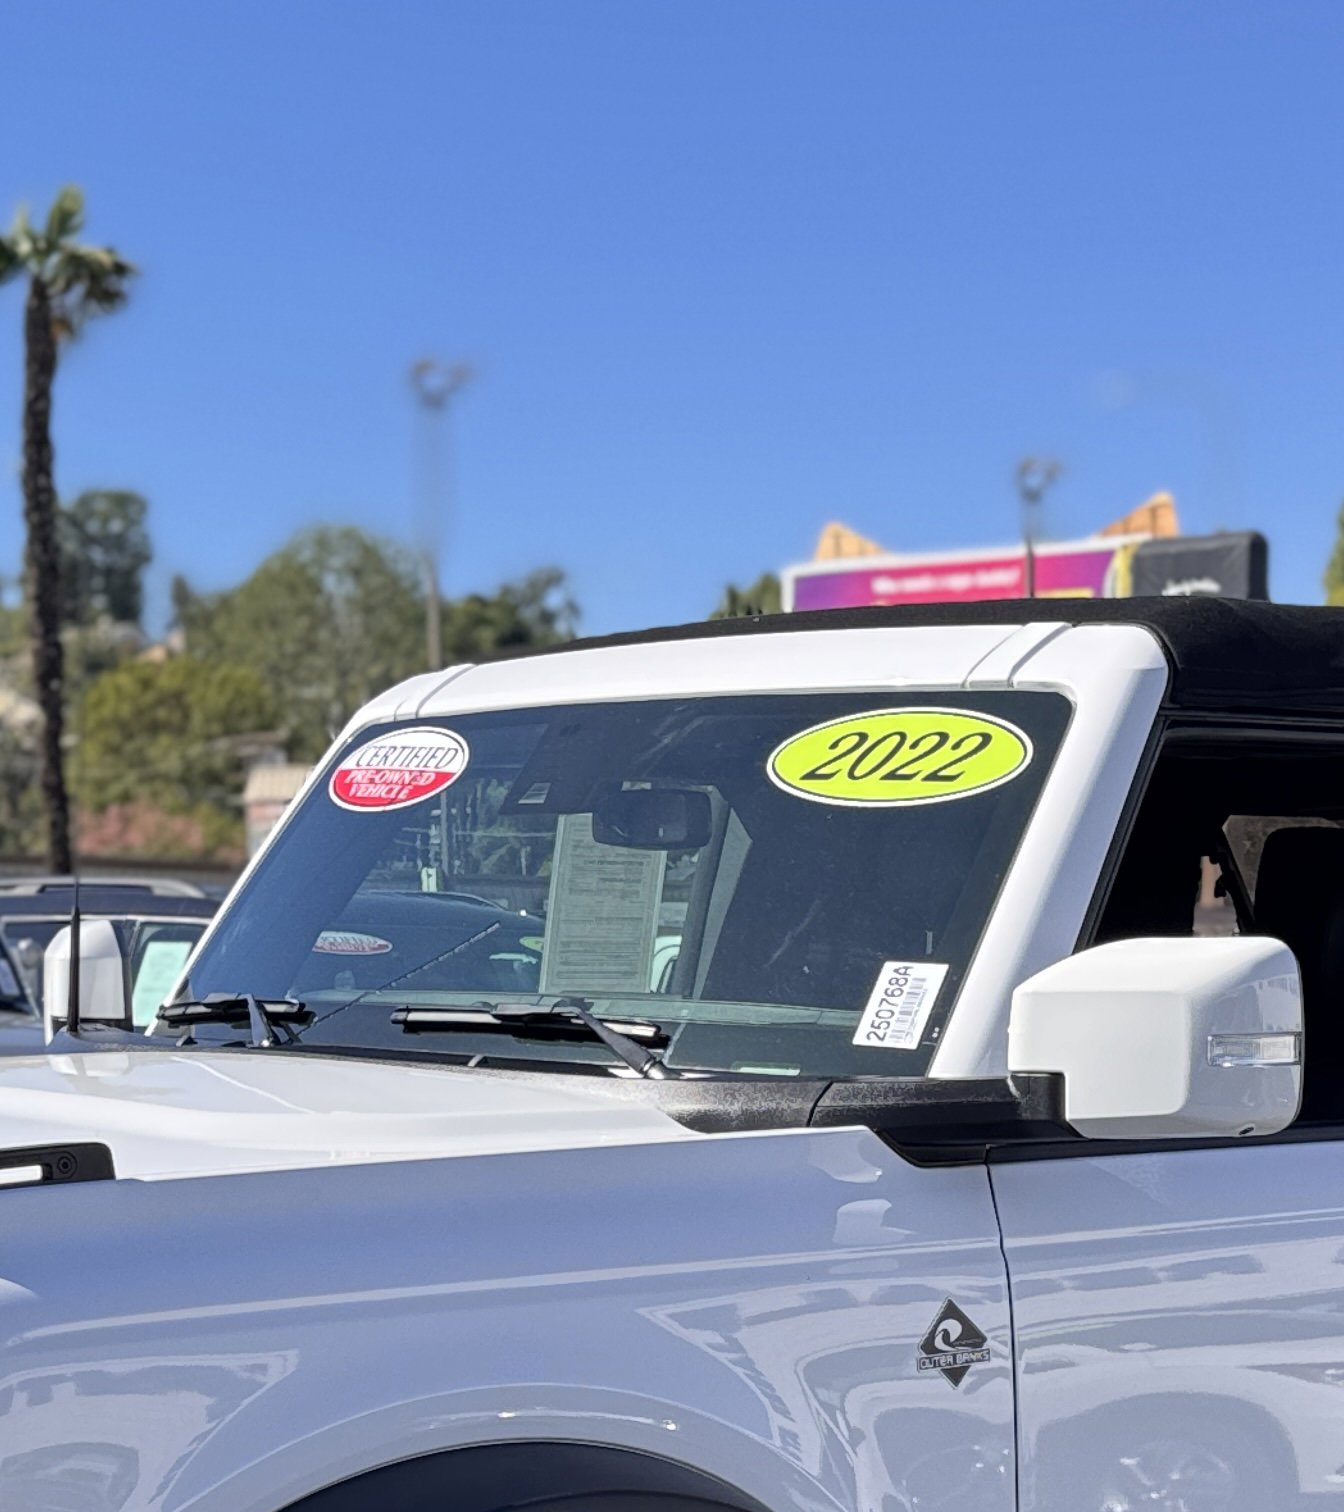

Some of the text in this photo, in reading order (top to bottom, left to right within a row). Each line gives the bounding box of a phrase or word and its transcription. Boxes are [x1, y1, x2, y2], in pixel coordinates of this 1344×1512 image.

[355, 745, 459, 770] CERTIFIED
[799, 731, 993, 783] 2022
[347, 782, 415, 800] VEHICLE
[866, 966, 915, 1042] 250768A
[920, 1350, 990, 1369] OUTER BANKS
